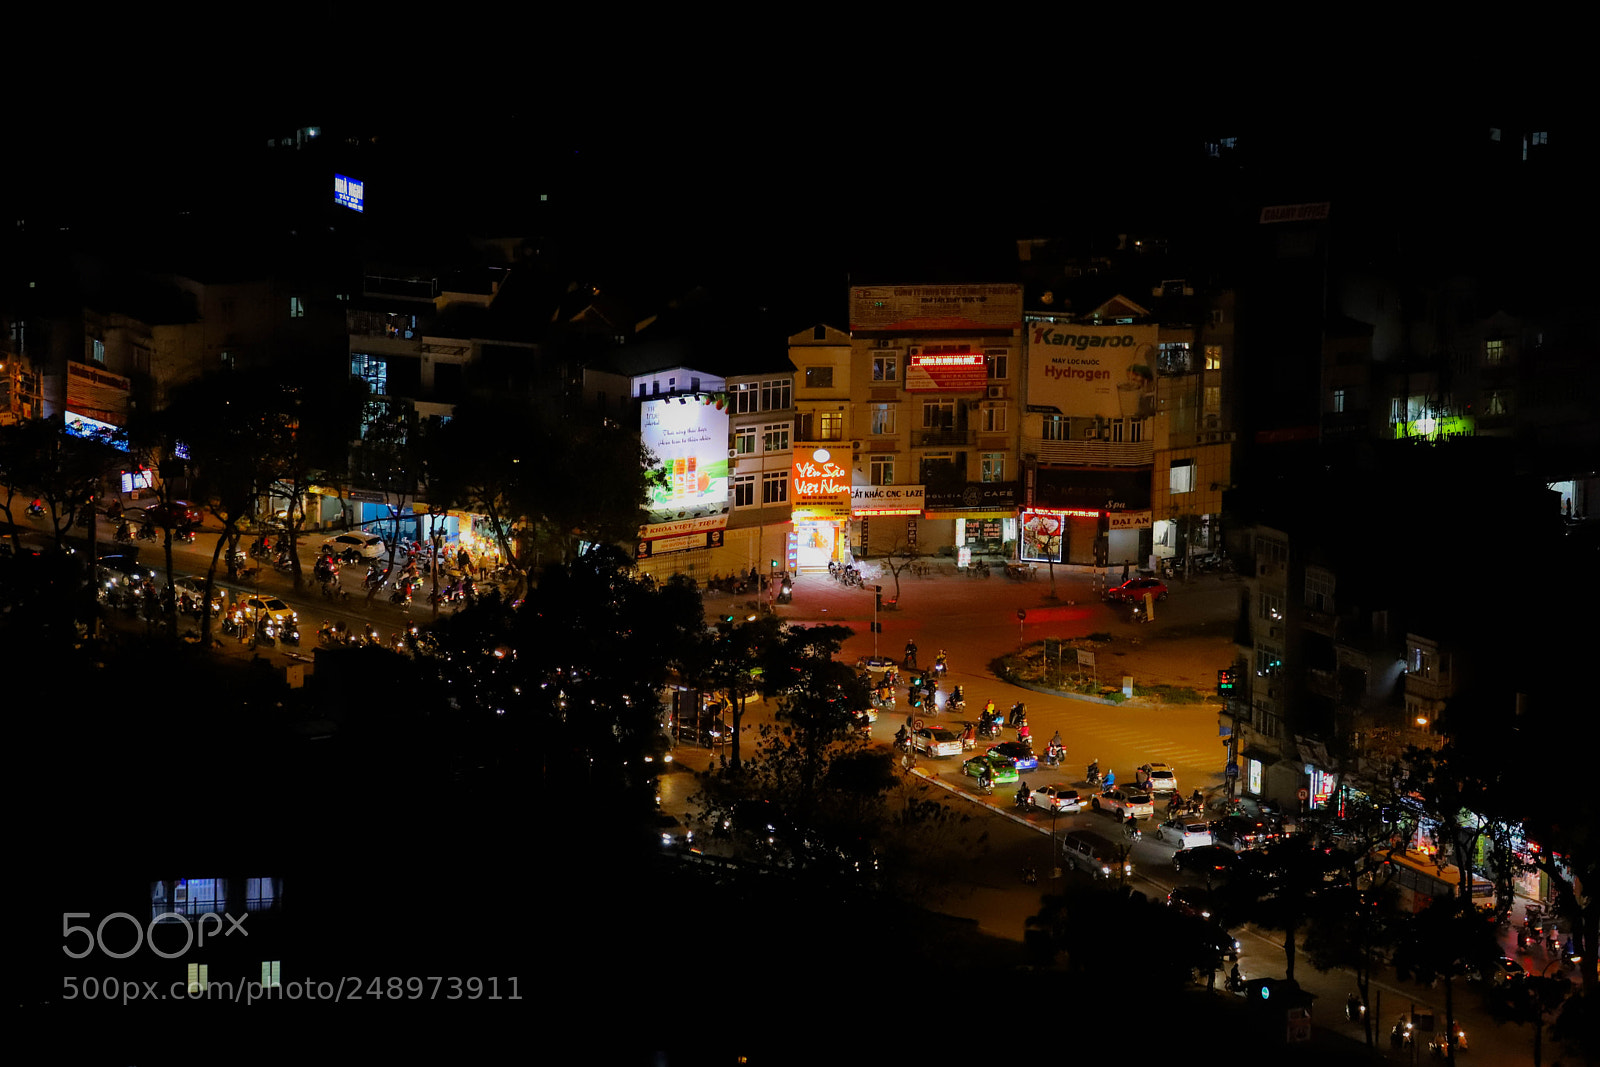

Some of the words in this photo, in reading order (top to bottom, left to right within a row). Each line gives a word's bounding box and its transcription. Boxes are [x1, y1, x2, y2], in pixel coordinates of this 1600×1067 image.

[1045, 365, 1110, 381] Hydrogen
[821, 462, 845, 478] Sào
[820, 478, 850, 494] Nam
[886, 490, 902, 498] CNC
[905, 490, 923, 498] LAZE
[1105, 499, 1126, 509] Spa
